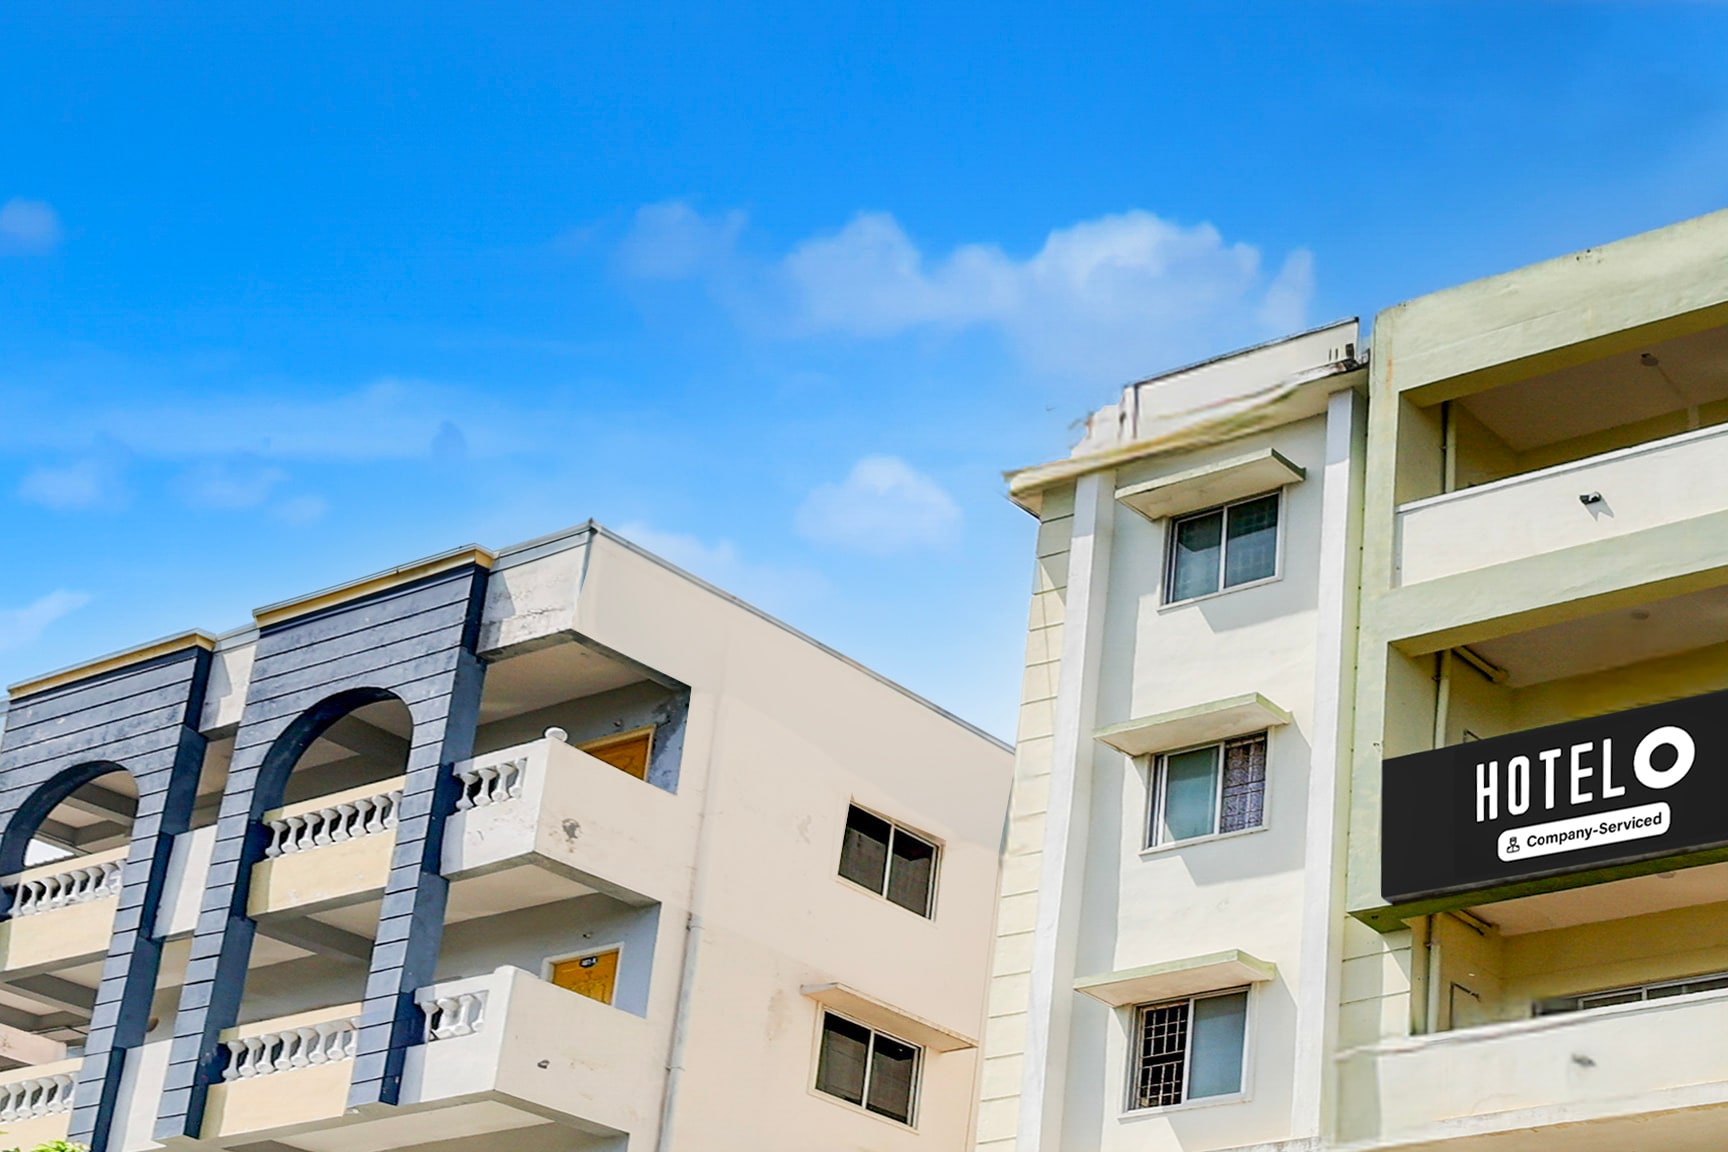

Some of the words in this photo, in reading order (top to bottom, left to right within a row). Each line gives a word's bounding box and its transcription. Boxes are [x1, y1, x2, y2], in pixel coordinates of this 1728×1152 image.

[1475, 738, 1626, 822] HOTEL
[1633, 725, 1696, 789] O
[1526, 811, 1662, 849] Company-Serviced
